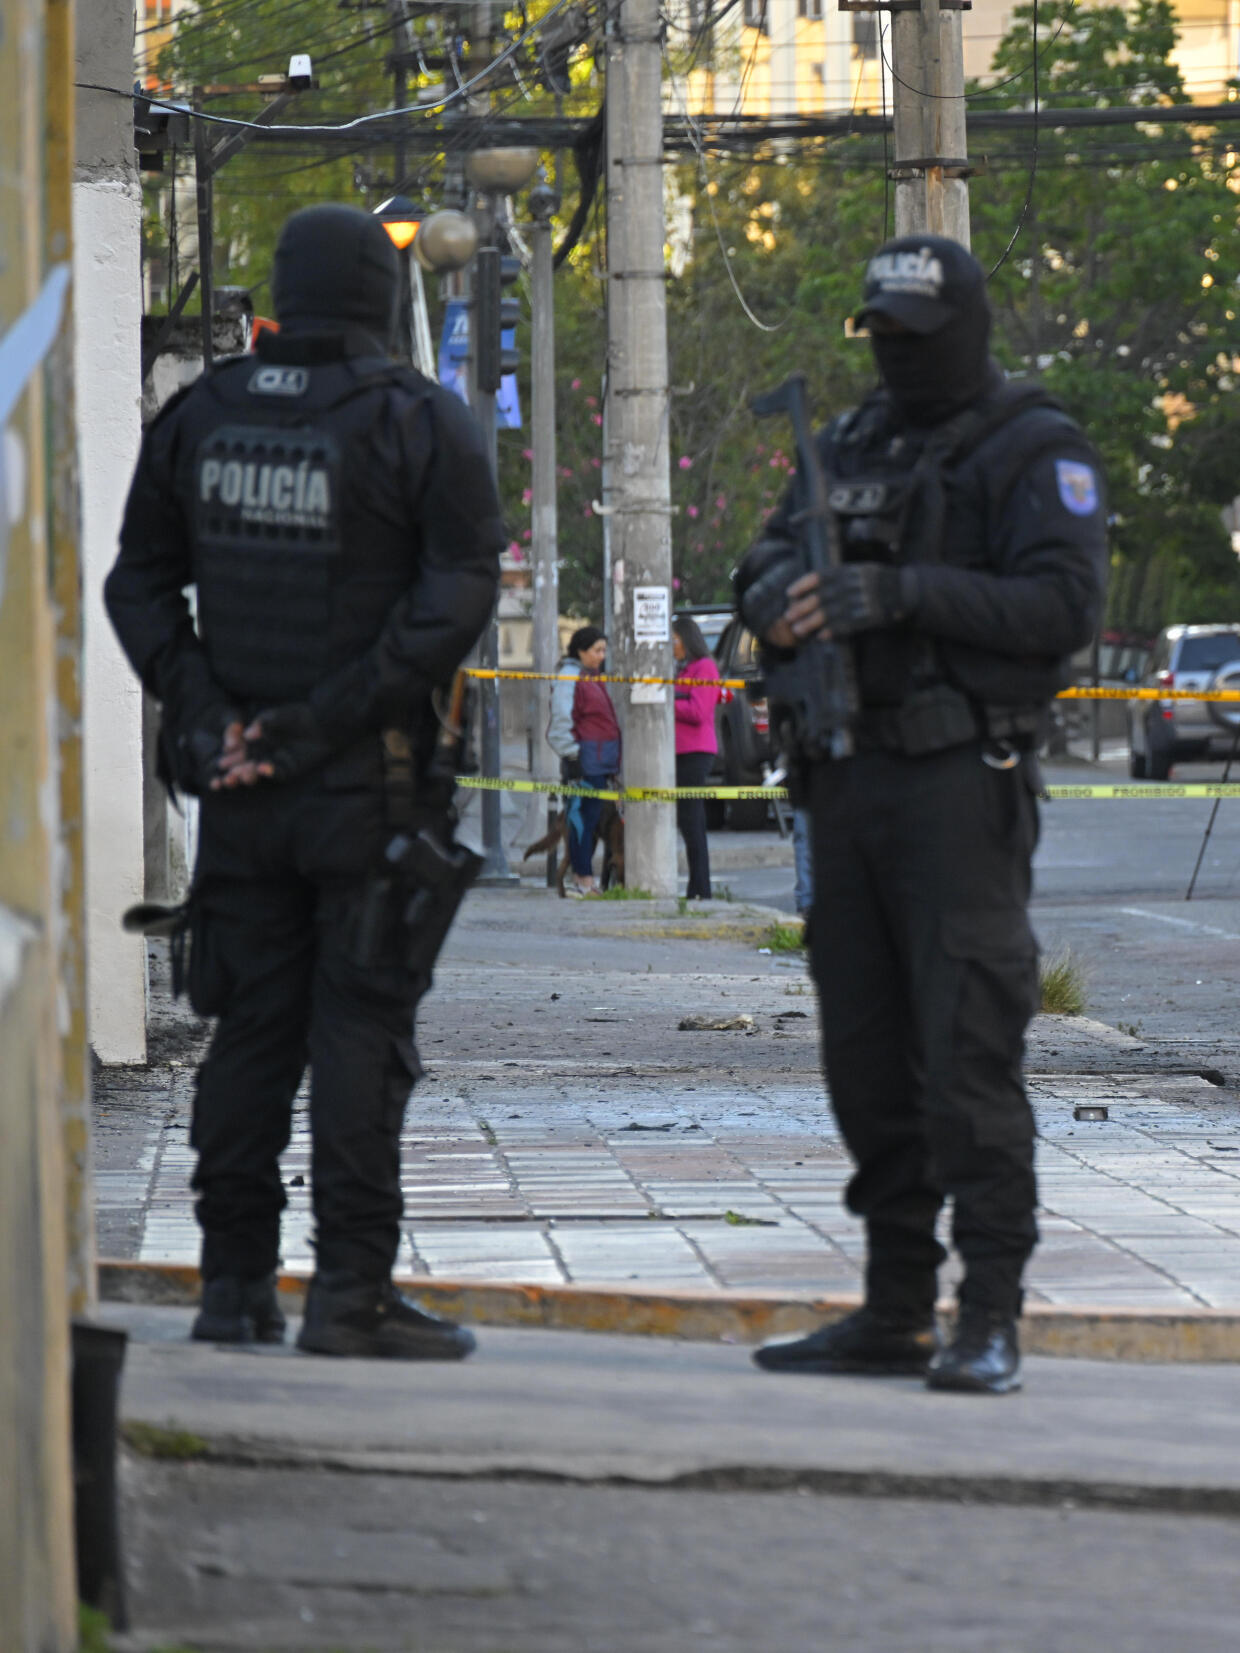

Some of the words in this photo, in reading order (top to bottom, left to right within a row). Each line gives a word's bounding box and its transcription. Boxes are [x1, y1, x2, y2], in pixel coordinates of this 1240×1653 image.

[201, 459, 330, 515] POLICÍA
[642, 790, 717, 800] PROHIBIDO
[1112, 787, 1186, 798] PROHIBIDO
